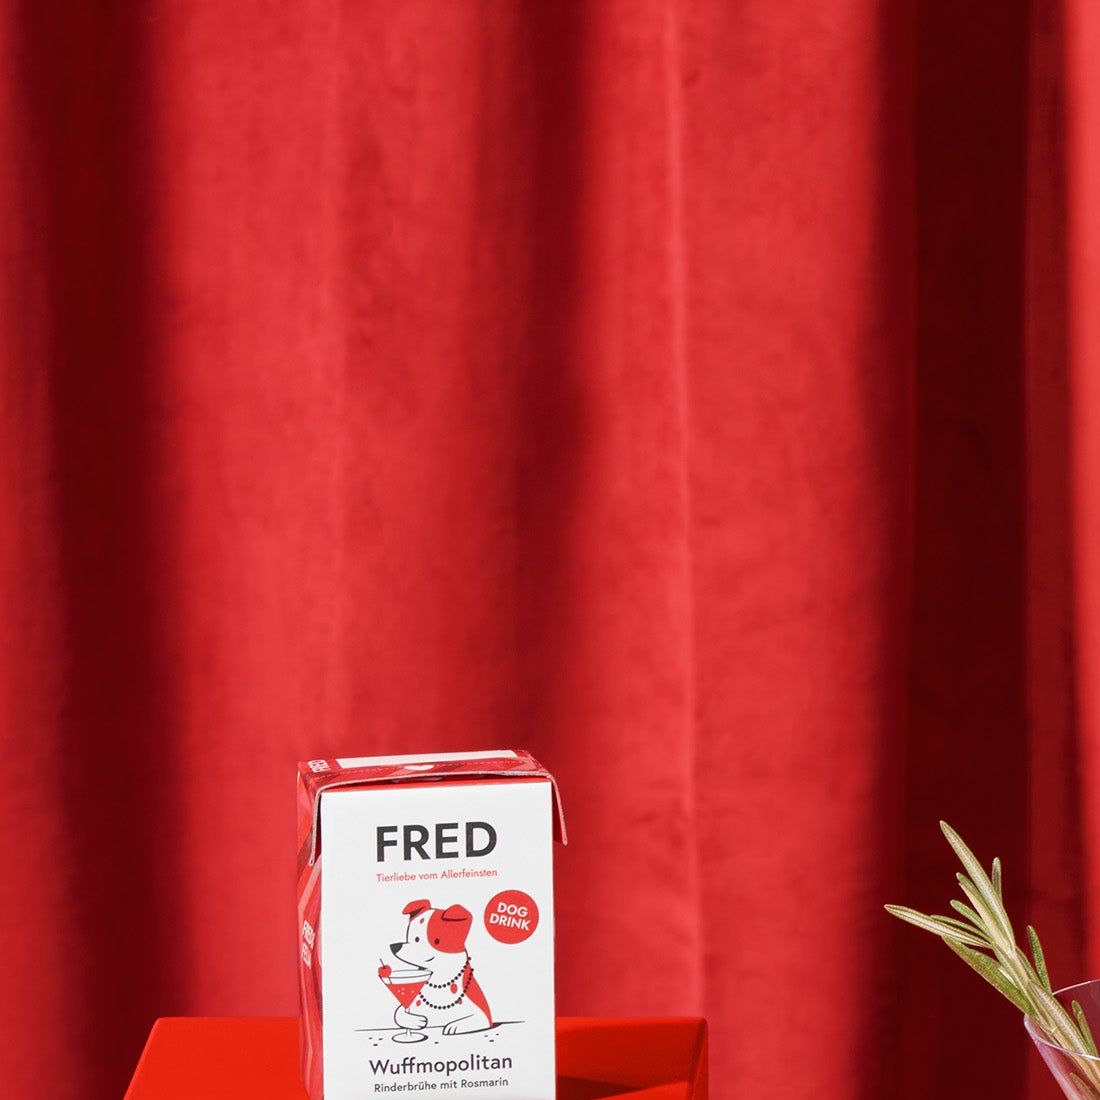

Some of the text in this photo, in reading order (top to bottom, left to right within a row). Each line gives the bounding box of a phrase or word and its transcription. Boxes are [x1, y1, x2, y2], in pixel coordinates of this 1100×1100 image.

[376, 821, 497, 862] FRED
[376, 868, 498, 882] Tierliebe vom Allerfeinsten
[497, 902, 528, 917] DOG
[490, 913, 531, 931] DRINK
[369, 1054, 512, 1076] Wuffmopolitan
[374, 1077, 509, 1093] Rinderbrühe mit Rosmarin
